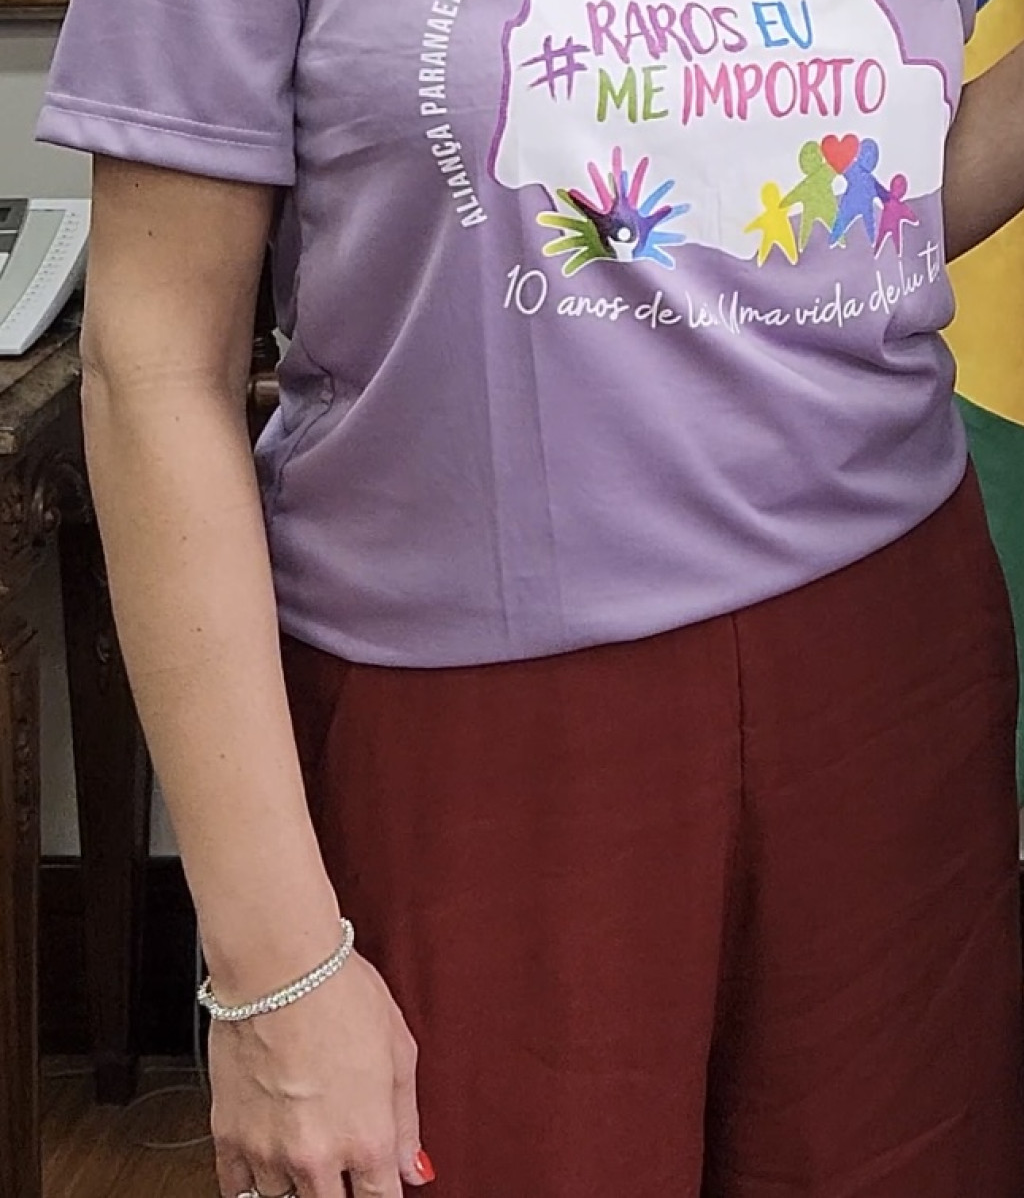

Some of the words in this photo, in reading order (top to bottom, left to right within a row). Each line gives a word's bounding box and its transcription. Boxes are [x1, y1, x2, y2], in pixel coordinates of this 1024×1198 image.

[751, 0, 813, 49] EU
[596, 64, 669, 123] ME
[681, 58, 886, 125] IMPORTO
[426, 124, 487, 228] ALIANÇA
[503, 265, 547, 315] 10
[557, 293, 630, 320] anos
[634, 290, 682, 329] de
[718, 290, 790, 334] Uma
[796, 281, 863, 328] vida
[869, 270, 900, 314] de
